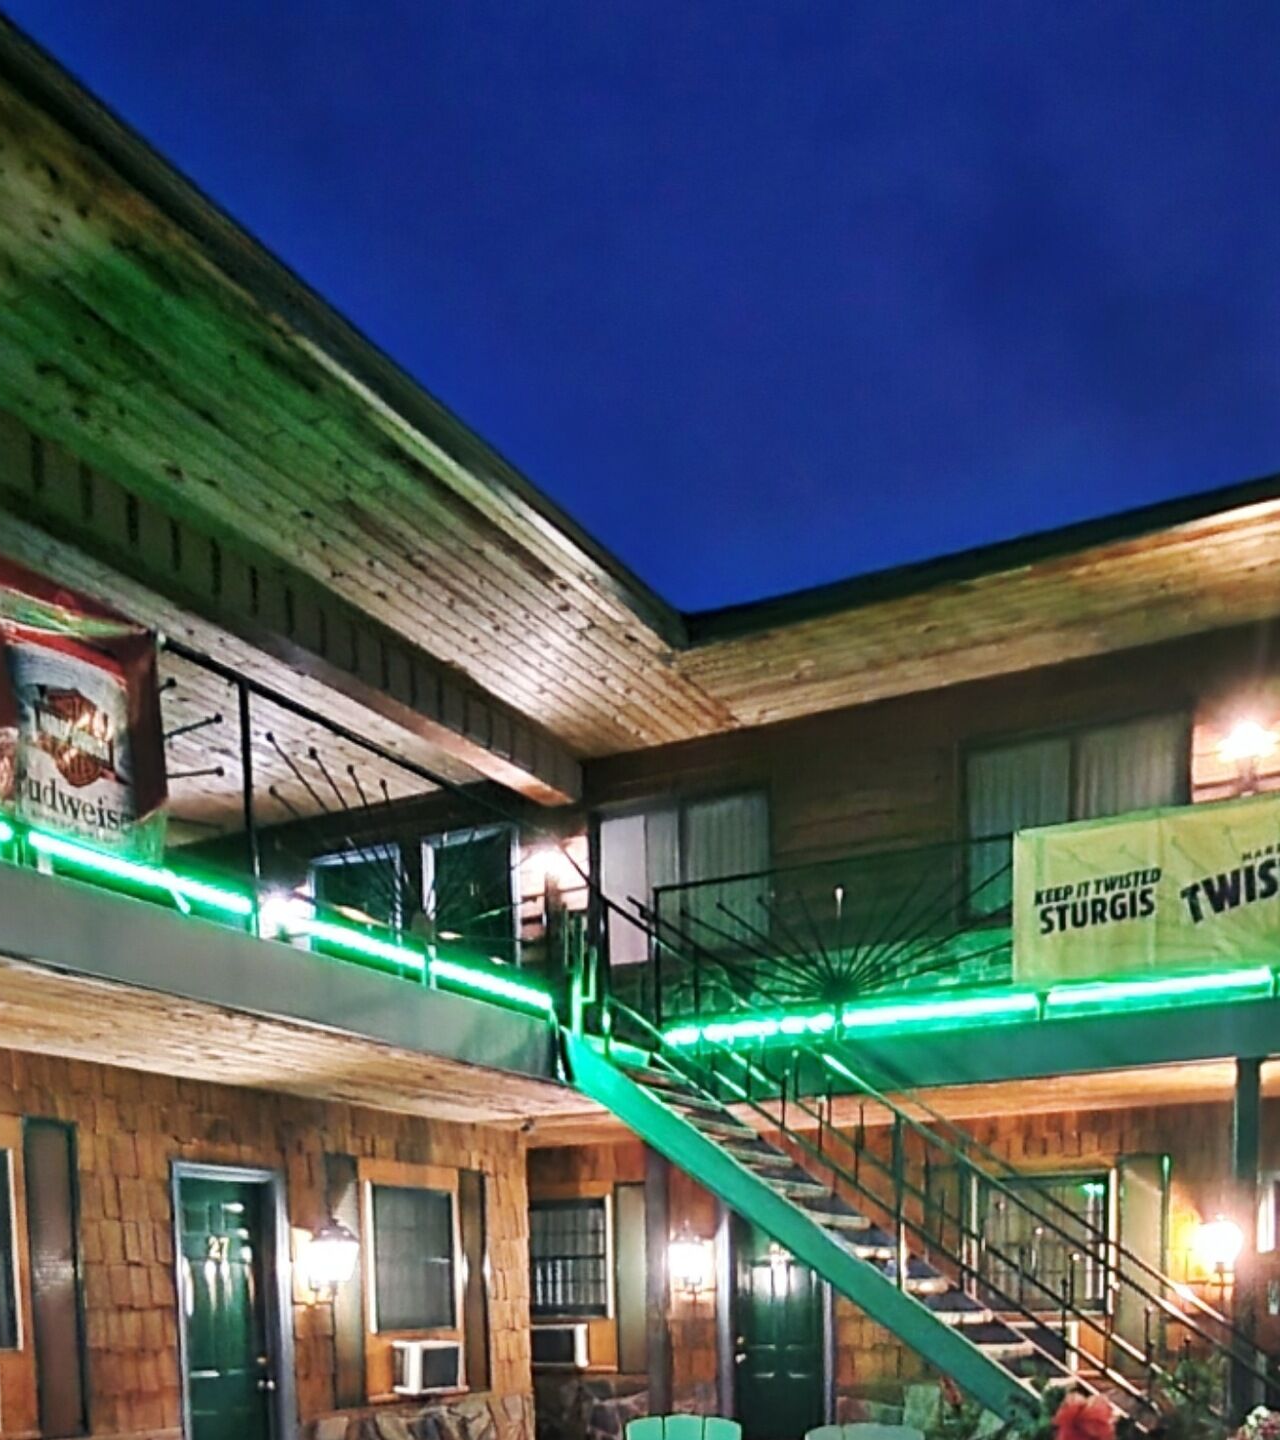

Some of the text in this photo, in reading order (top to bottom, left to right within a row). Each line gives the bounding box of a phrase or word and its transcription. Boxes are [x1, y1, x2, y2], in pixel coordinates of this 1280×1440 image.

[1034, 867, 1163, 907] KEEP IT TWISTED
[1039, 888, 1156, 935] STURGIS
[208, 1236, 230, 1261] 27
